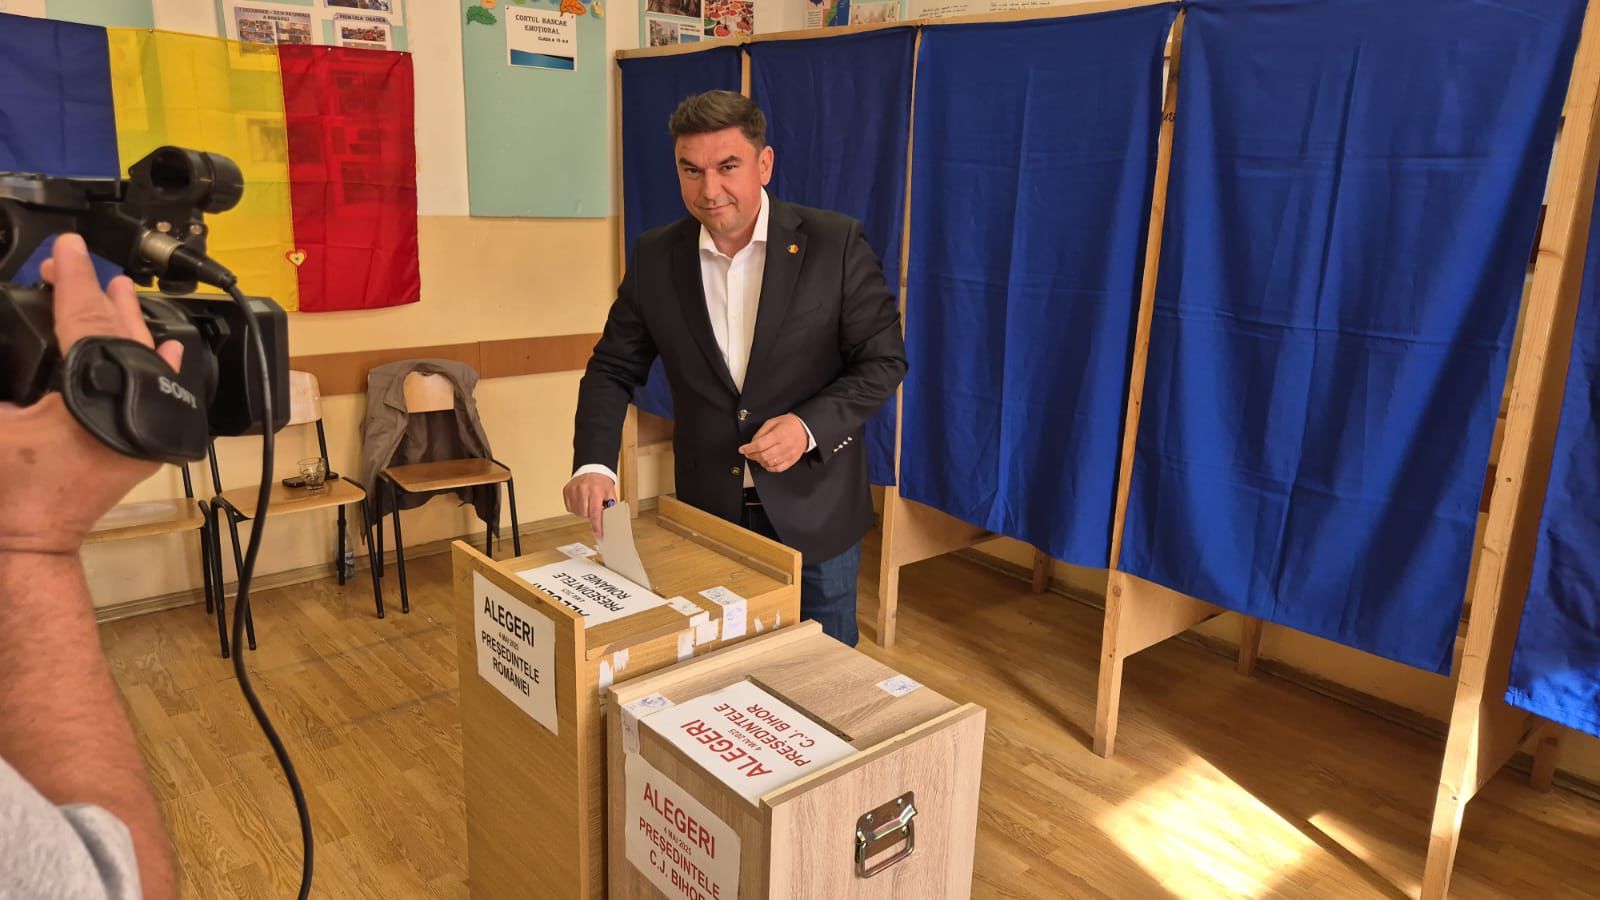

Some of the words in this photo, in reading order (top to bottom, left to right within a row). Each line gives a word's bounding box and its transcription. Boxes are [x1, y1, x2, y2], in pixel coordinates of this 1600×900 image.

[515, 14, 540, 23] CONTUL
[541, 17, 568, 26] BANCAR
[158, 375, 197, 409] SONY
[484, 596, 535, 648] ALEGERI
[481, 630, 540, 684] PREȘEDINTELE
[492, 657, 530, 697] ROMÂNIEI
[746, 703, 791, 732] BIHOR
[680, 719, 773, 778] ALEGERI
[713, 703, 812, 767] PREȘEDINTELE
[728, 728, 743, 742] 2025
[744, 738, 756, 748] MAI
[789, 729, 816, 748] C.J.
[643, 782, 715, 860] ALEGERI
[668, 830, 678, 843] MAI
[649, 850, 668, 878] C.J.
